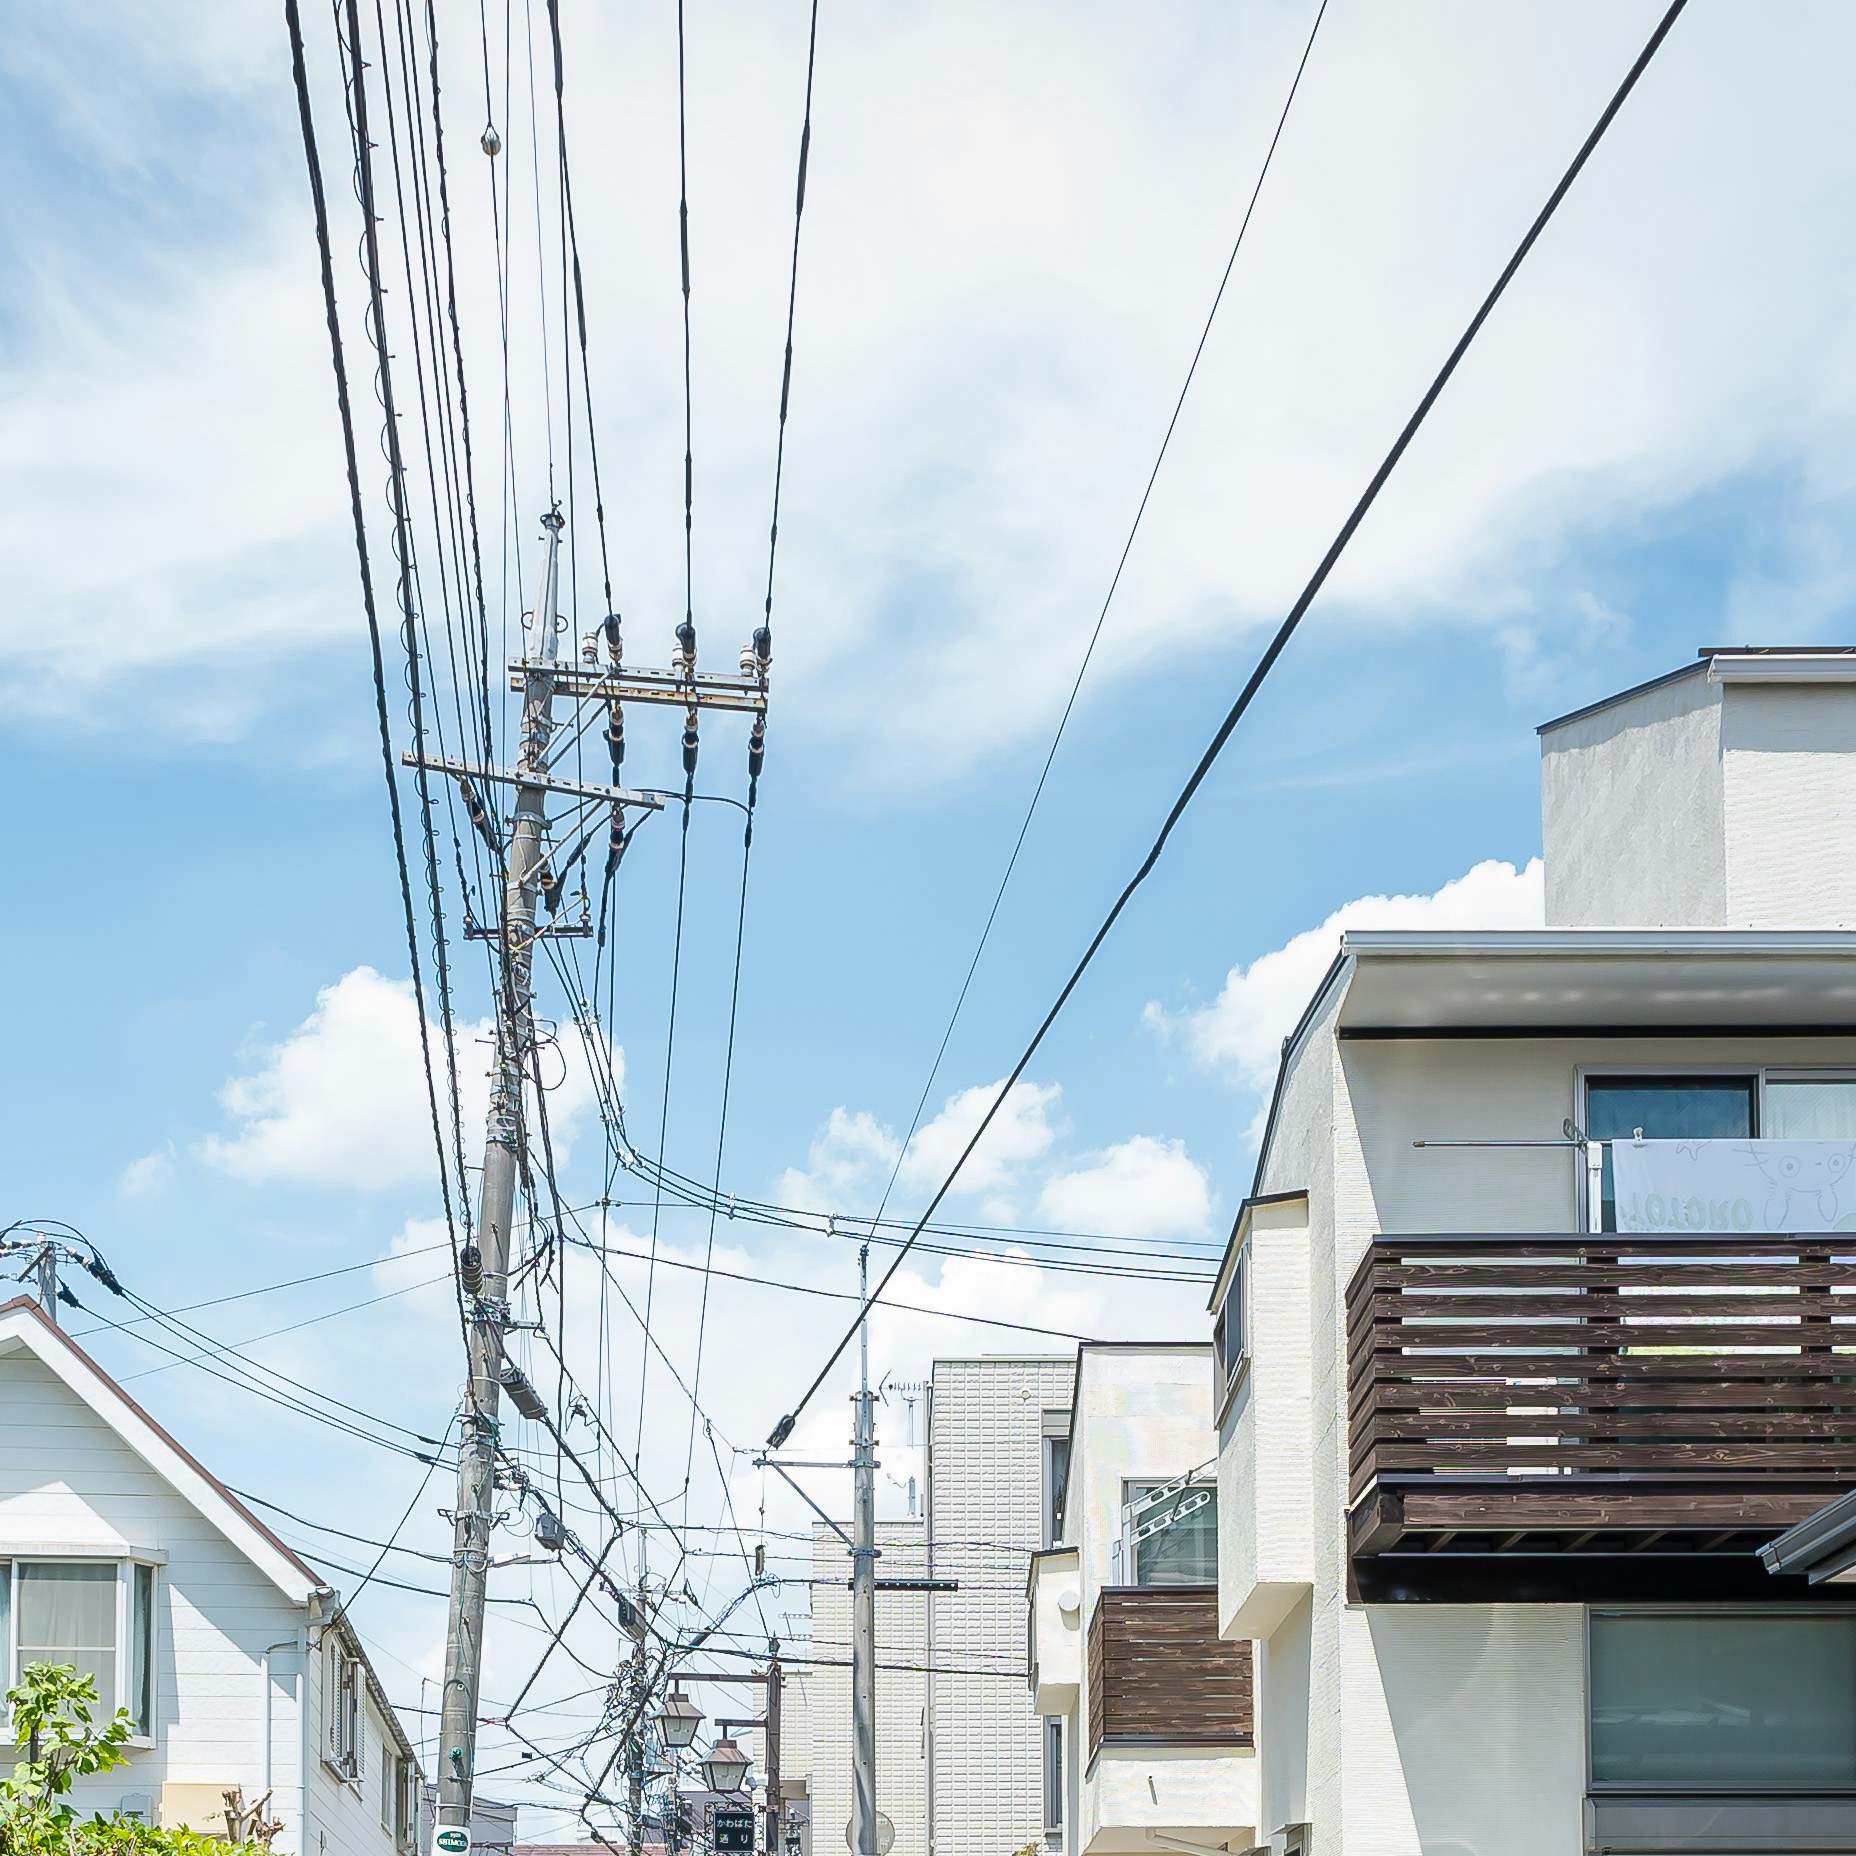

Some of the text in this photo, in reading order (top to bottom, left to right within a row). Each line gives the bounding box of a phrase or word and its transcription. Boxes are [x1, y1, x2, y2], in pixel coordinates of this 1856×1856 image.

[716, 1819, 752, 1828] かわばた
[719, 1833, 748, 1843] 通り
